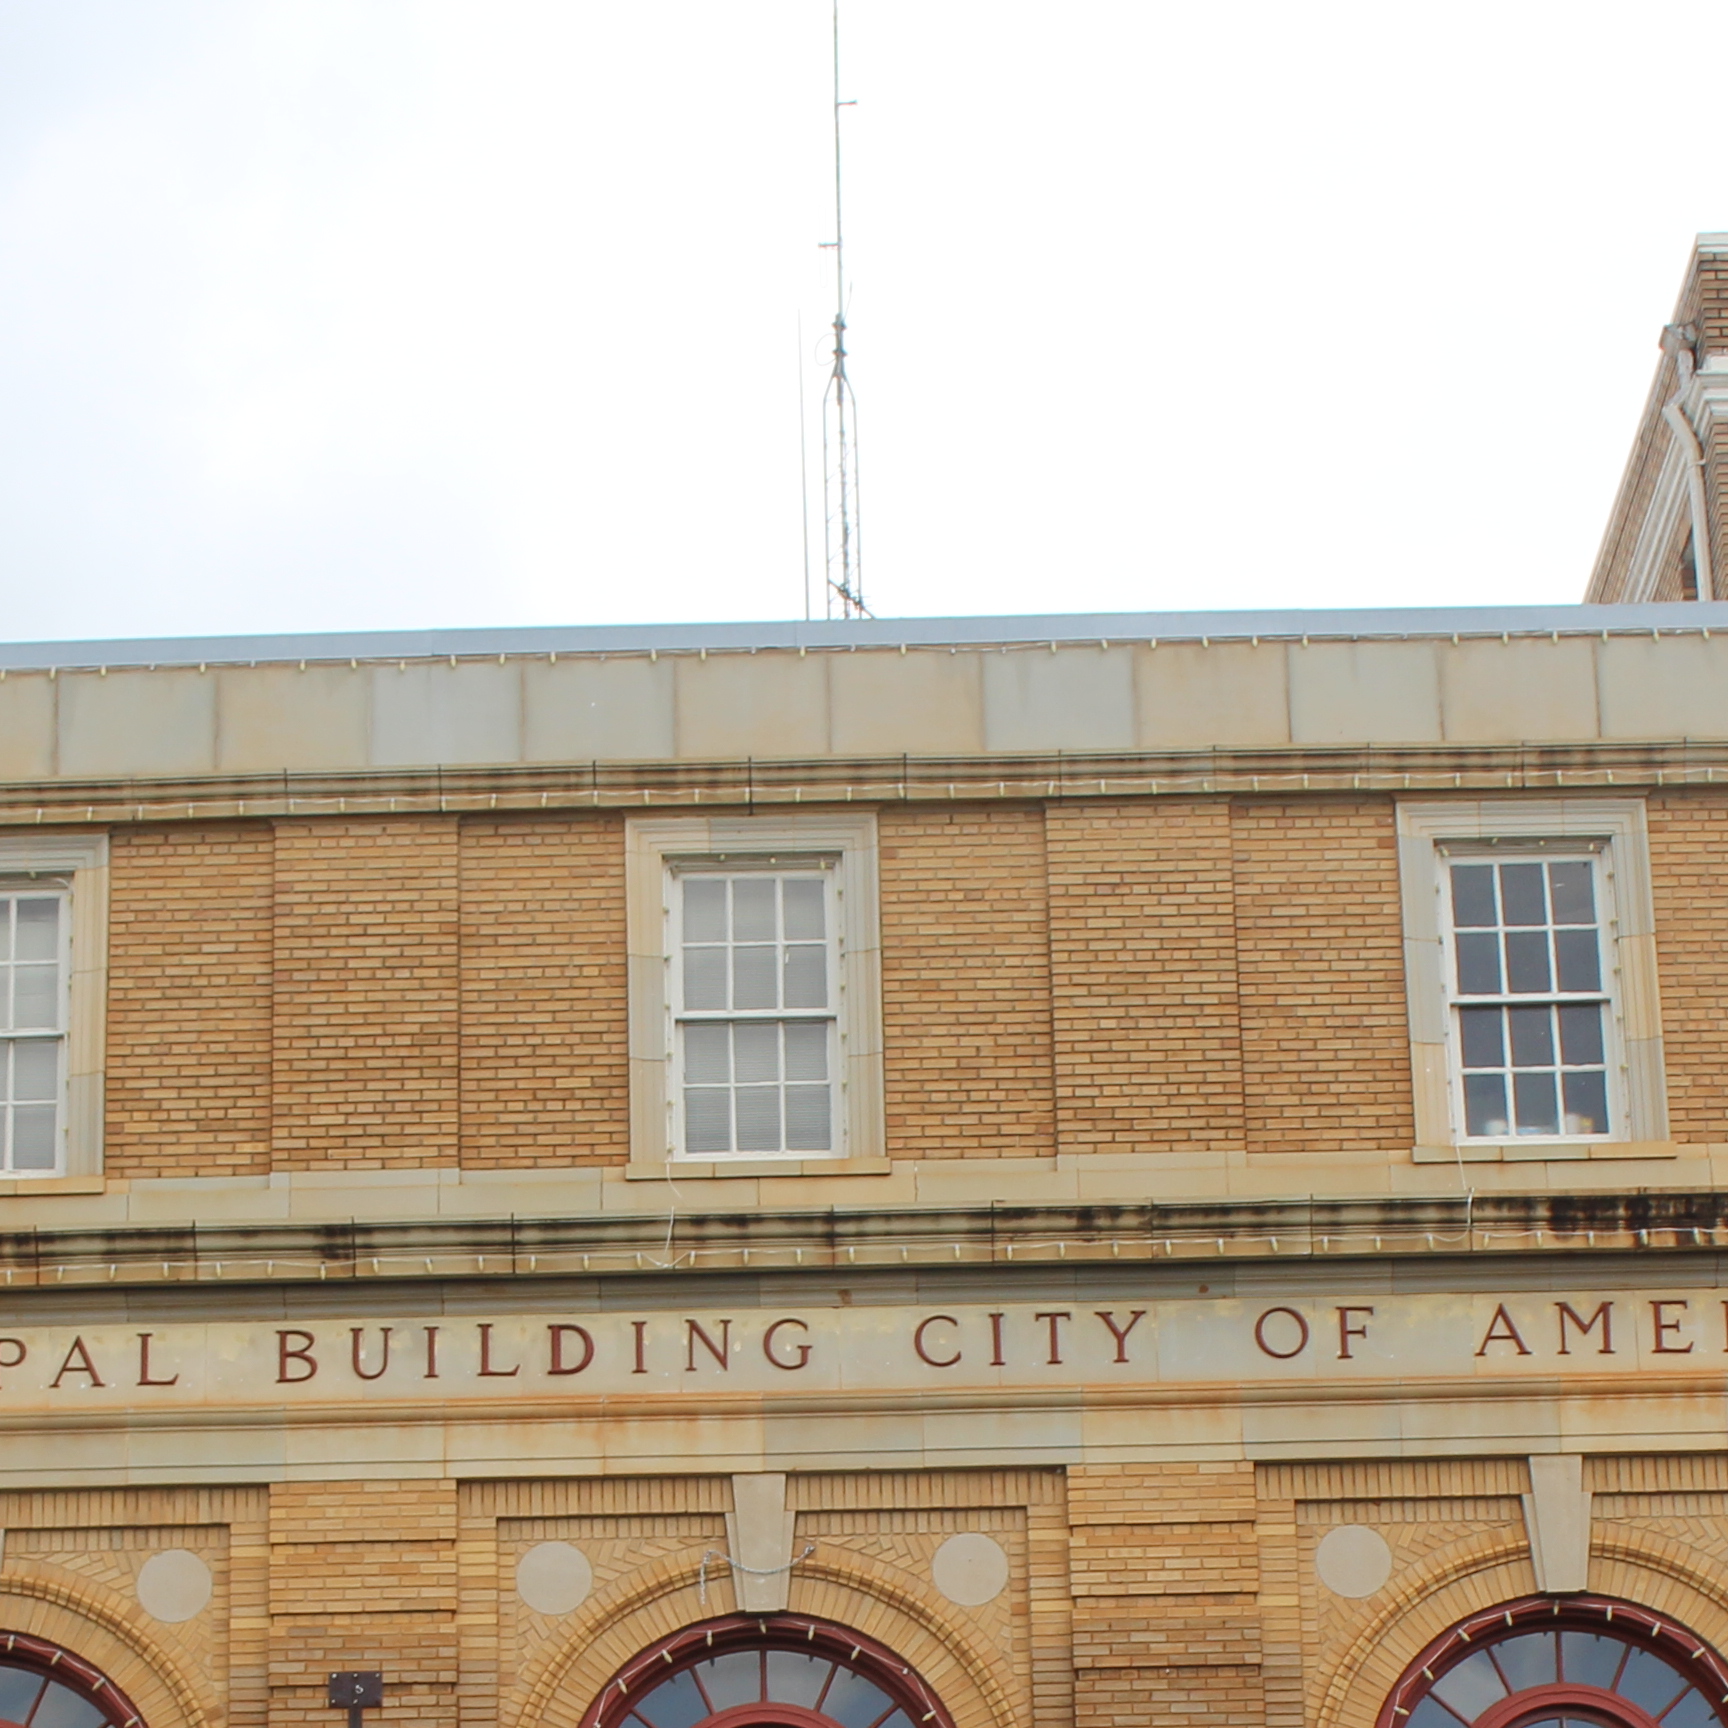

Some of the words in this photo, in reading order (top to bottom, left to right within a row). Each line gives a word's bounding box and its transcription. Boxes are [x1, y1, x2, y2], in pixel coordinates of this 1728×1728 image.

[275, 1318, 813, 1384] BUILDING
[914, 1310, 1147, 1368] CITY
[1254, 1306, 1375, 1360] OF
